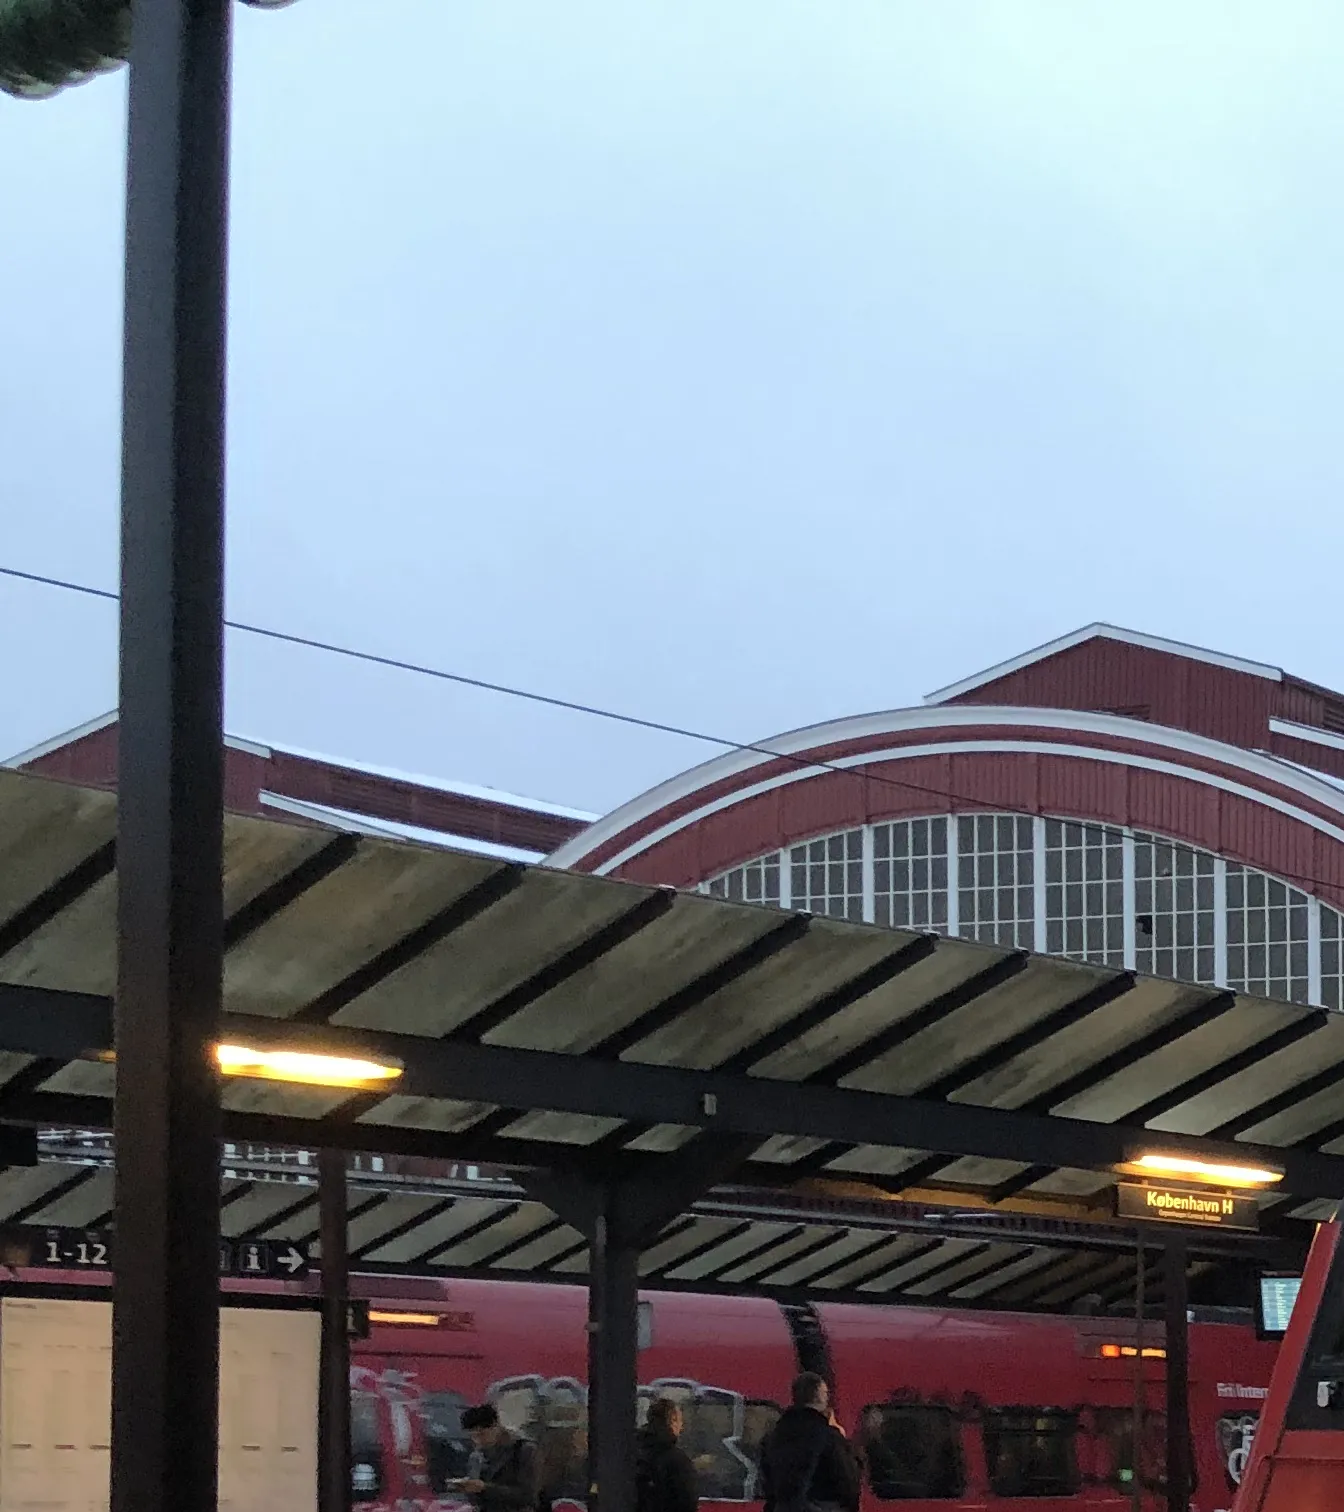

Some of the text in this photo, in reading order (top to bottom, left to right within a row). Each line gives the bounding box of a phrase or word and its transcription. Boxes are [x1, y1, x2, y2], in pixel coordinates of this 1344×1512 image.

[1146, 1191, 1233, 1214] København H
[46, 1241, 108, 1264] 1-12
